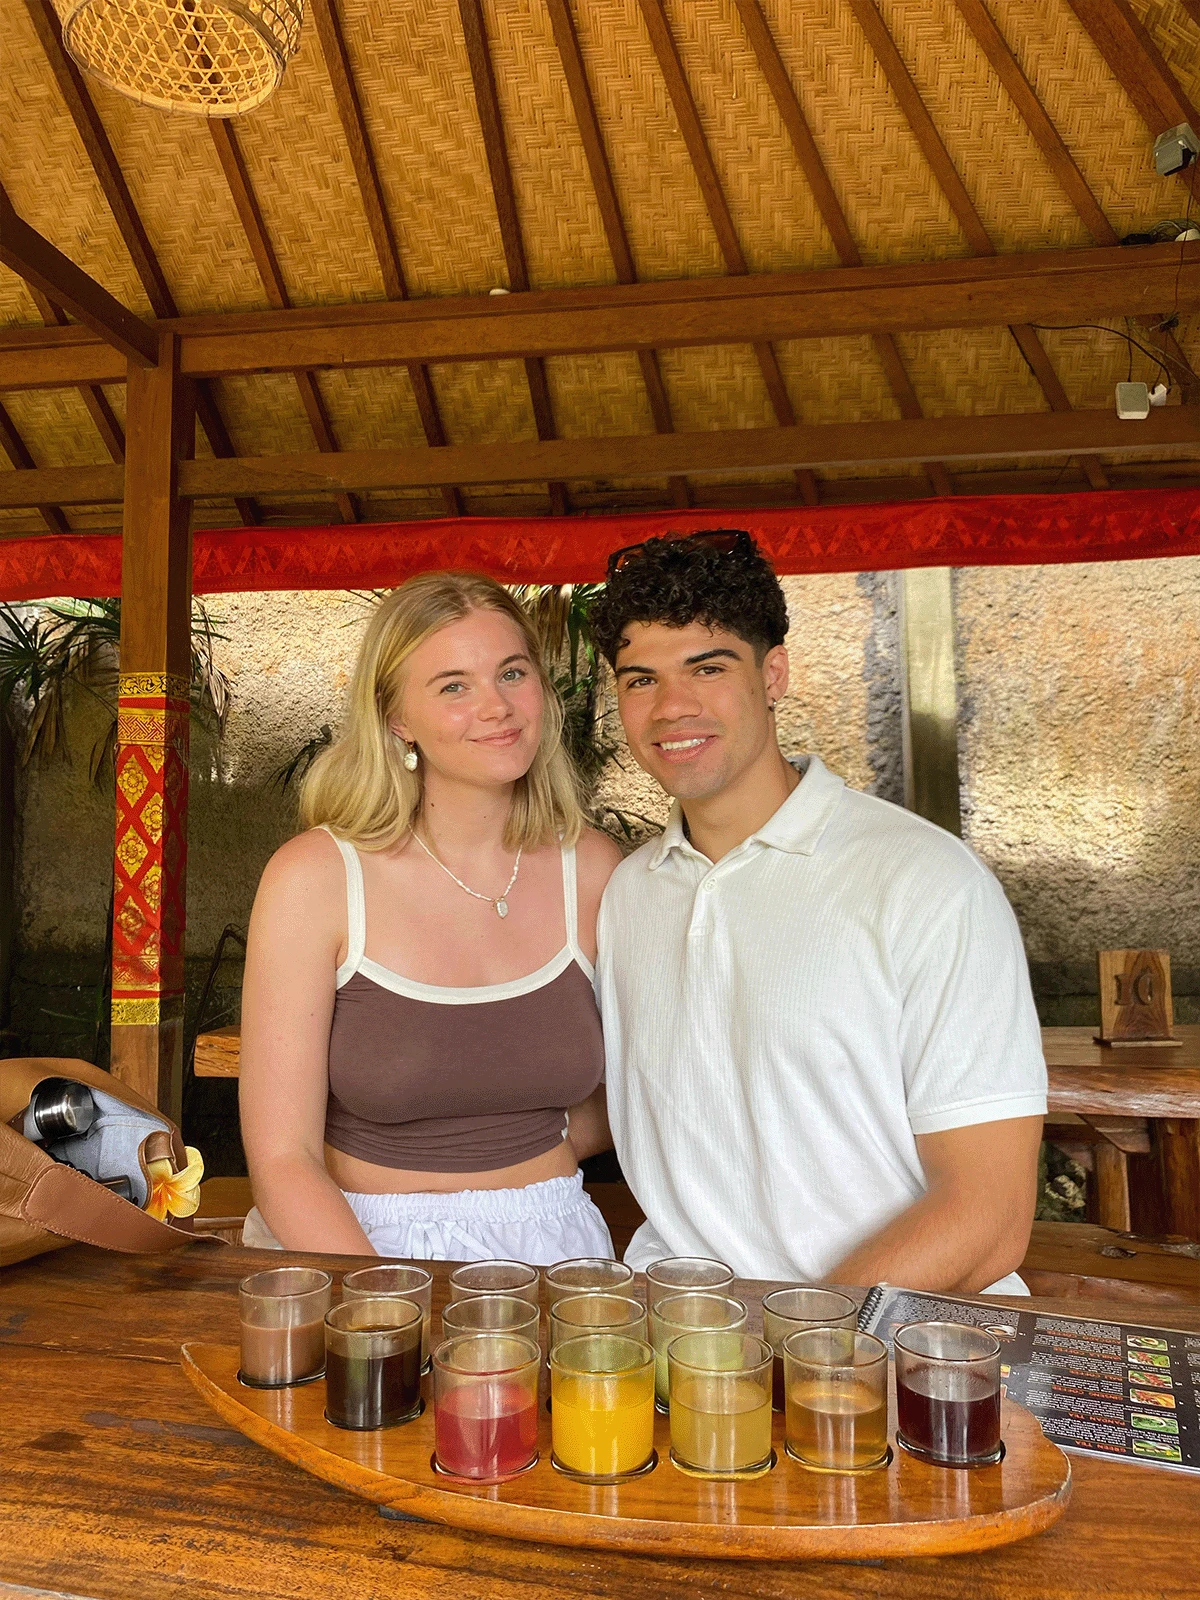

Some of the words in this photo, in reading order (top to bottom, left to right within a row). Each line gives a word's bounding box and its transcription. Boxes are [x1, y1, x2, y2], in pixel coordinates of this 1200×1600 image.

[1053, 1346, 1085, 1356] COFFEE
[1052, 1385, 1085, 1395] COFFEE
[1068, 1411, 1085, 1420] TEA
[1089, 1416, 1126, 1426] PANDAN
[1074, 1439, 1093, 1448] TEA
[1096, 1443, 1127, 1453] GREEN
